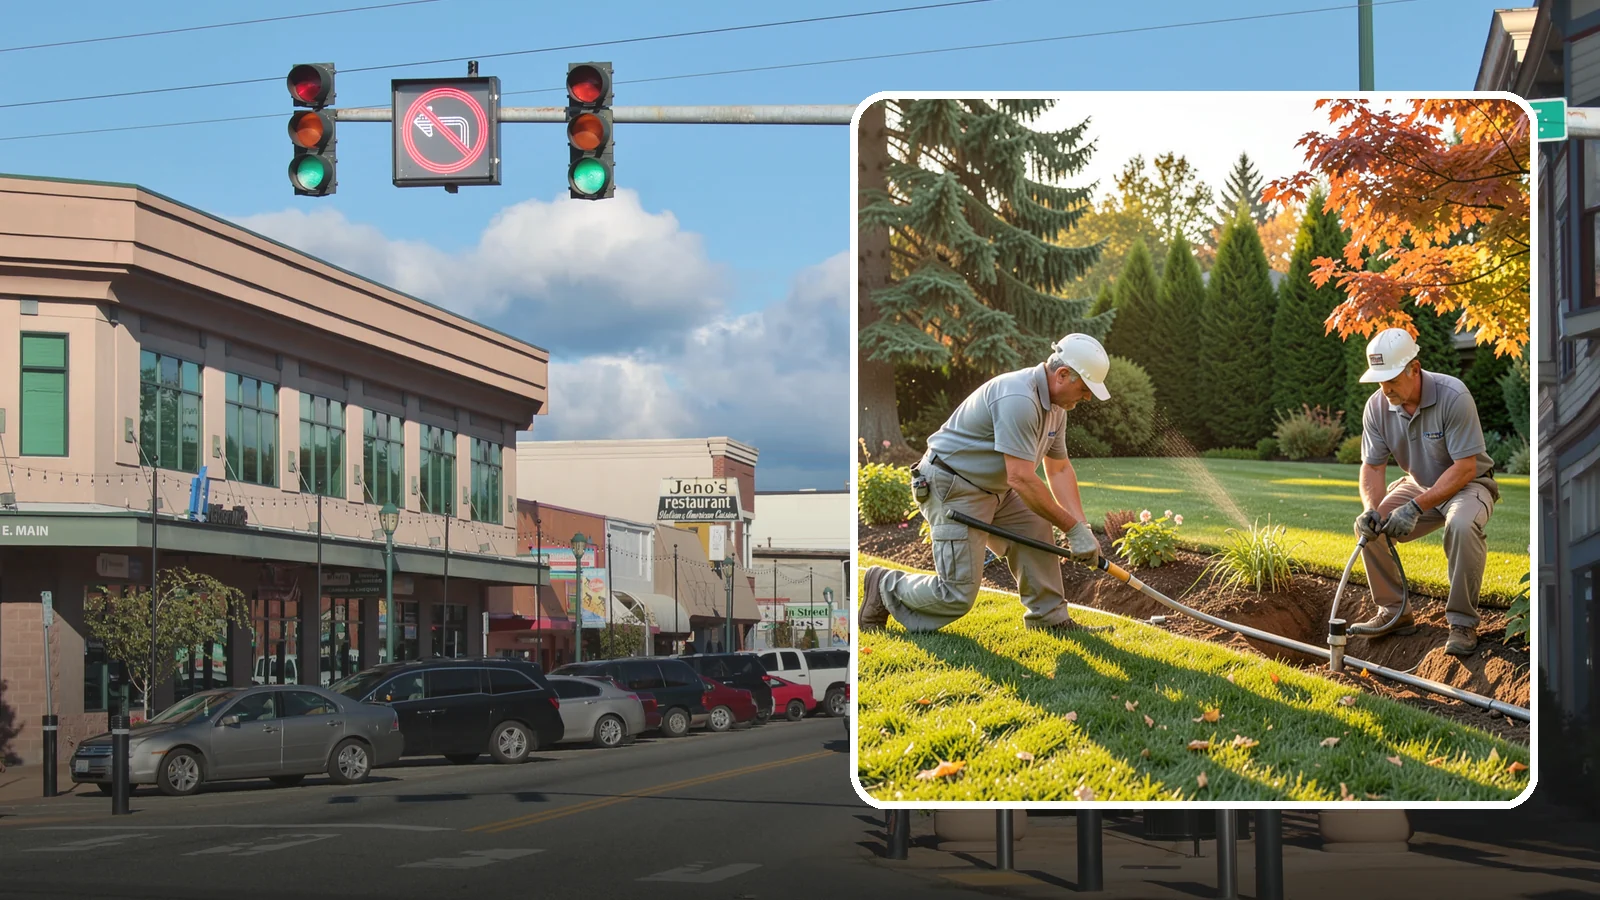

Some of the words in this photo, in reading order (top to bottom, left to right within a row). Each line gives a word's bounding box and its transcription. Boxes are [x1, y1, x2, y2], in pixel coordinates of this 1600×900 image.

[669, 480, 727, 494] Jeno's
[665, 496, 731, 509] restaurant
[715, 509, 737, 519] Cuisine
[2, 525, 13, 536] E.
[15, 525, 49, 536] MAIN
[797, 607, 828, 617] Street
